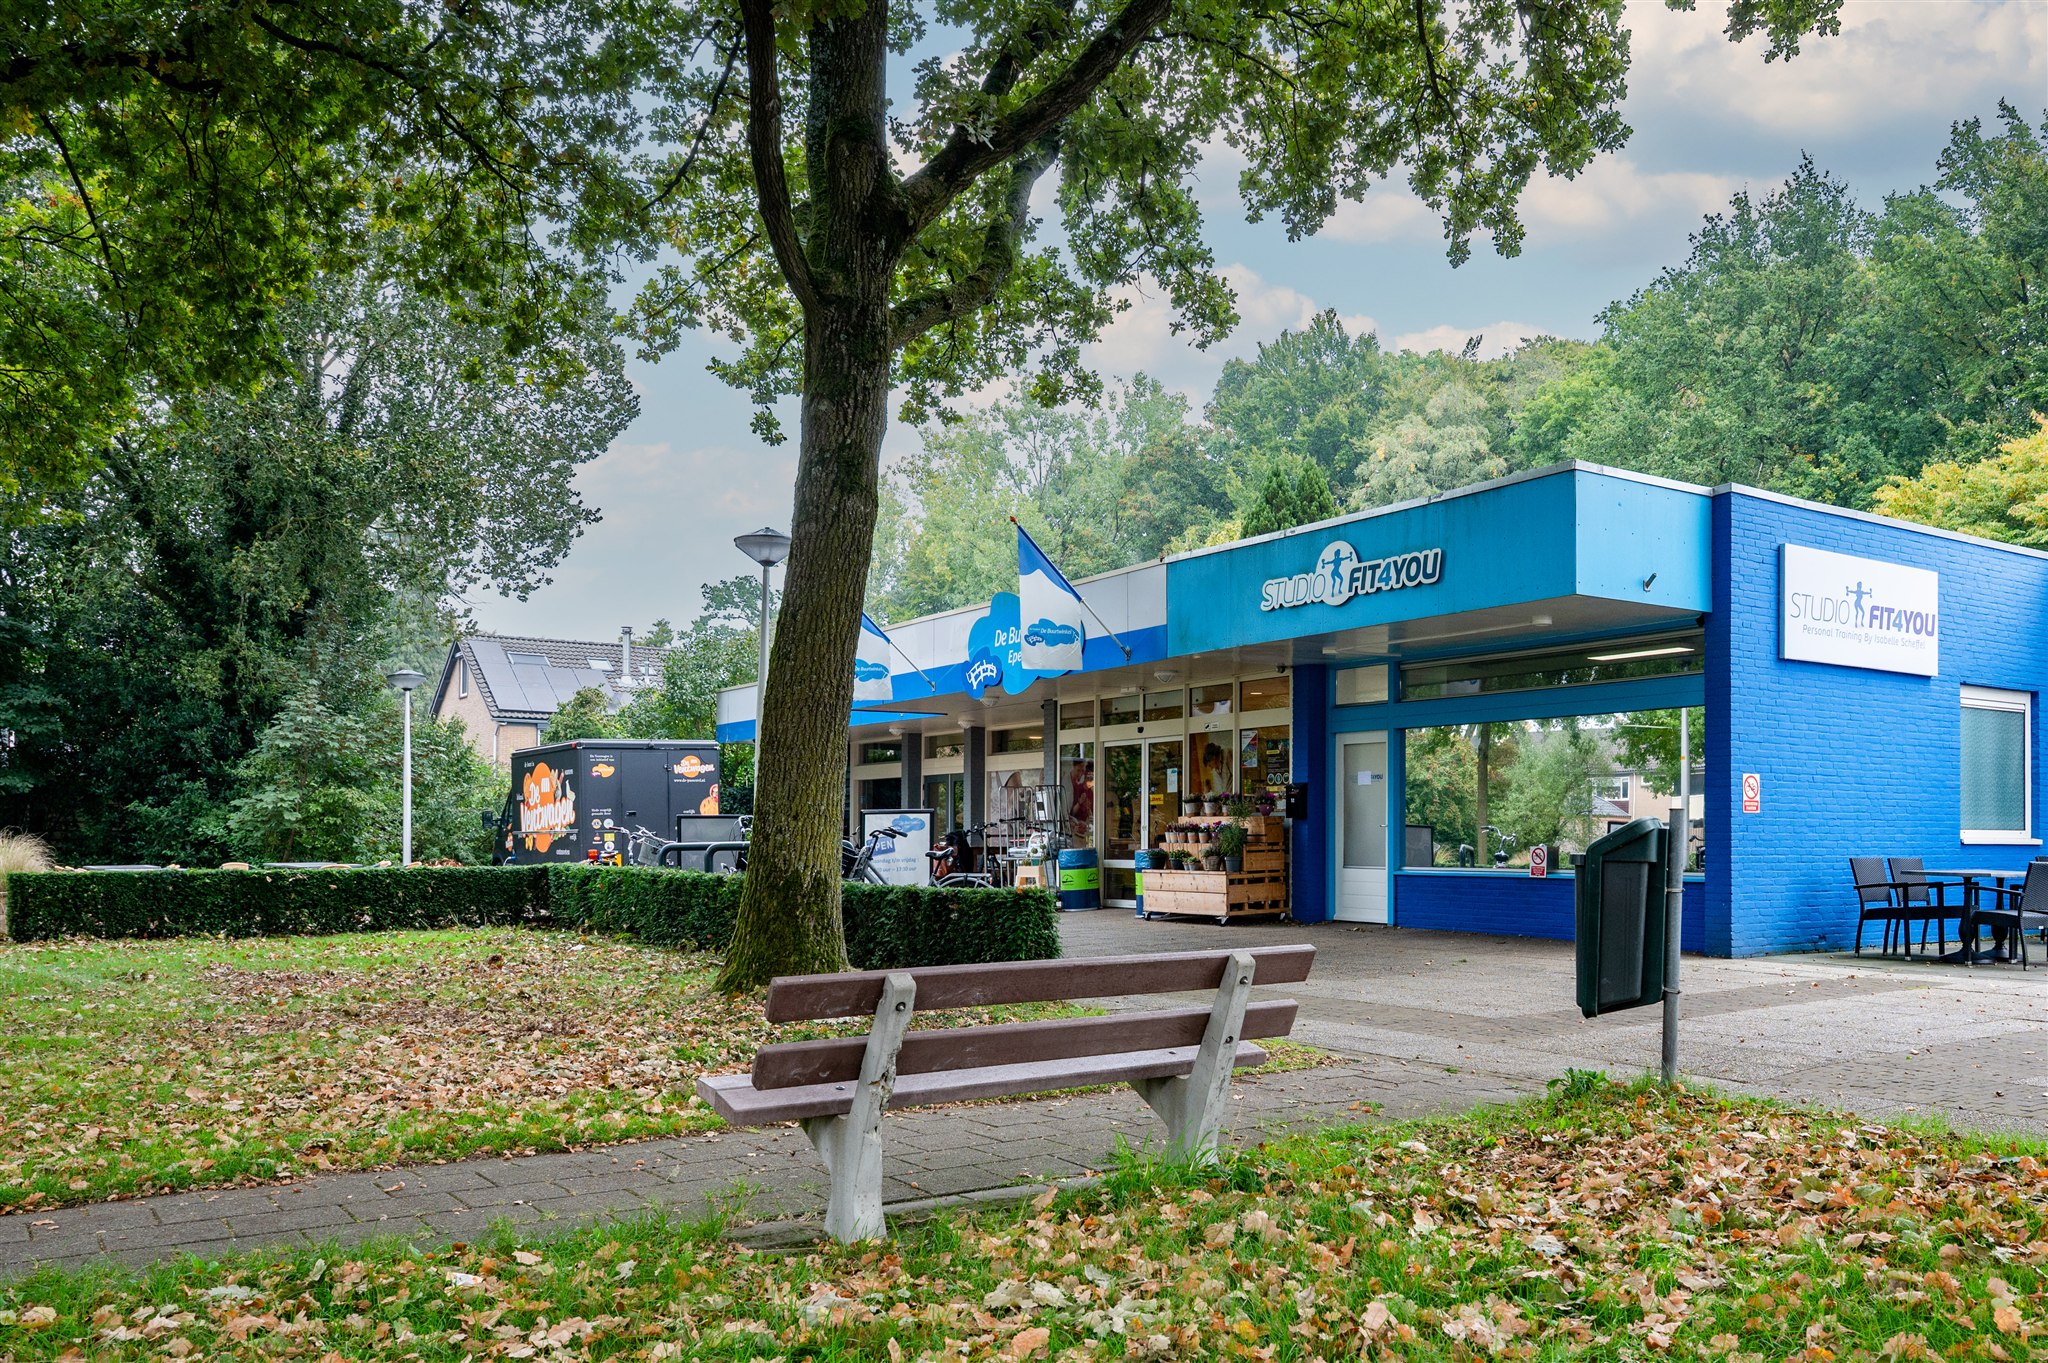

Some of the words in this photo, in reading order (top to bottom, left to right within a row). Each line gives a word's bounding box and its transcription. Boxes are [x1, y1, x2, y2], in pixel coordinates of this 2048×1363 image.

[1263, 573, 1326, 608] STUDIO
[1350, 552, 1438, 593] FIT4YOU
[1790, 592, 1850, 624] STUDIO
[1868, 605, 1935, 637] FIT4YOU
[994, 629, 1007, 647] De
[1802, 624, 1833, 638] Personal
[1835, 629, 1862, 643] Training
[1864, 633, 1873, 645] By
[1874, 634, 1899, 646] Isabelle
[529, 781, 541, 806] De
